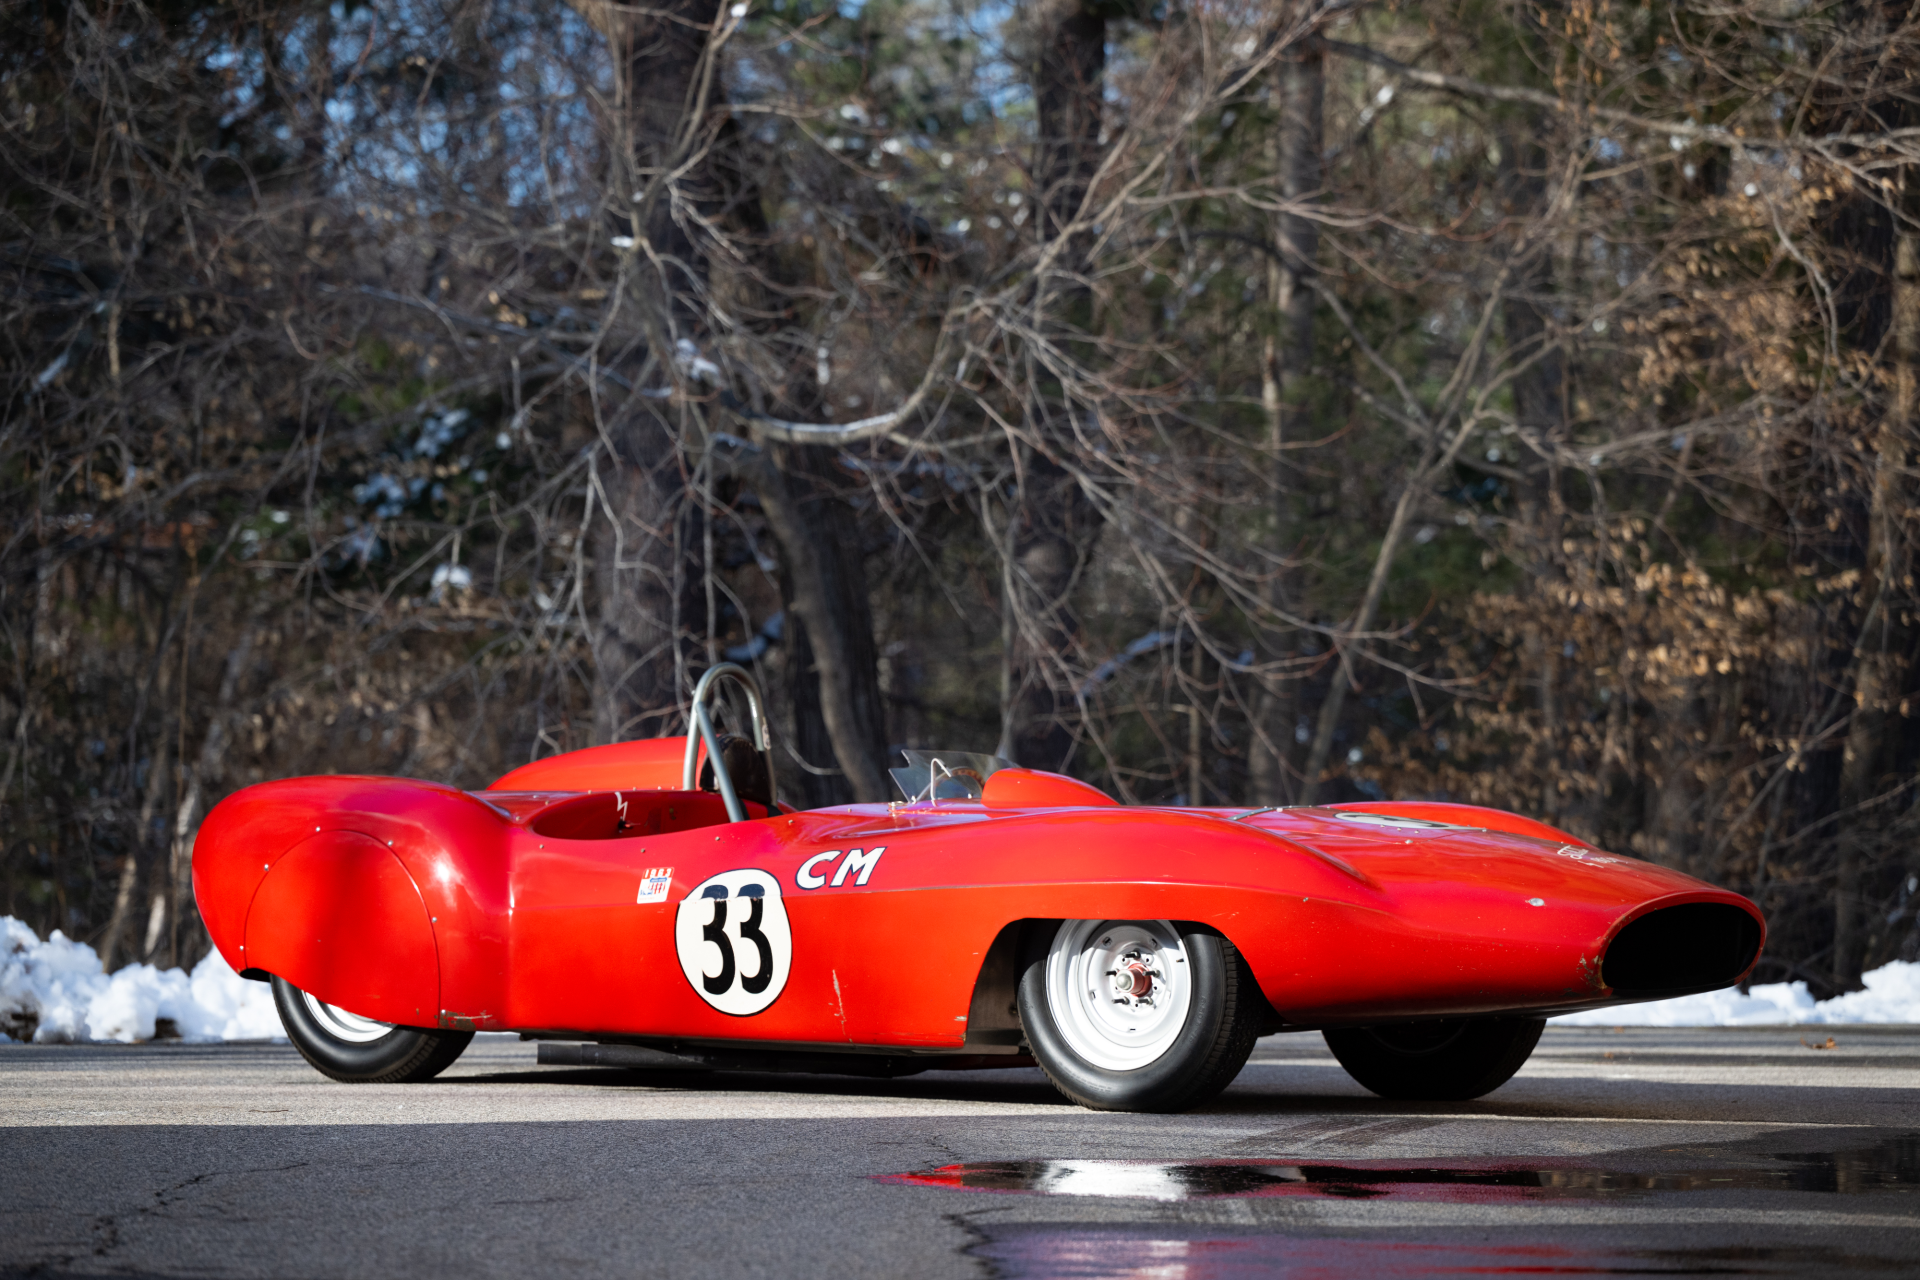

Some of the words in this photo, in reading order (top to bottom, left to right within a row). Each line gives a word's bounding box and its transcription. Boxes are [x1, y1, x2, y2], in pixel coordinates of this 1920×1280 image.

[644, 868, 672, 879] 1963
[796, 846, 888, 890] CM
[700, 883, 773, 995] 33
